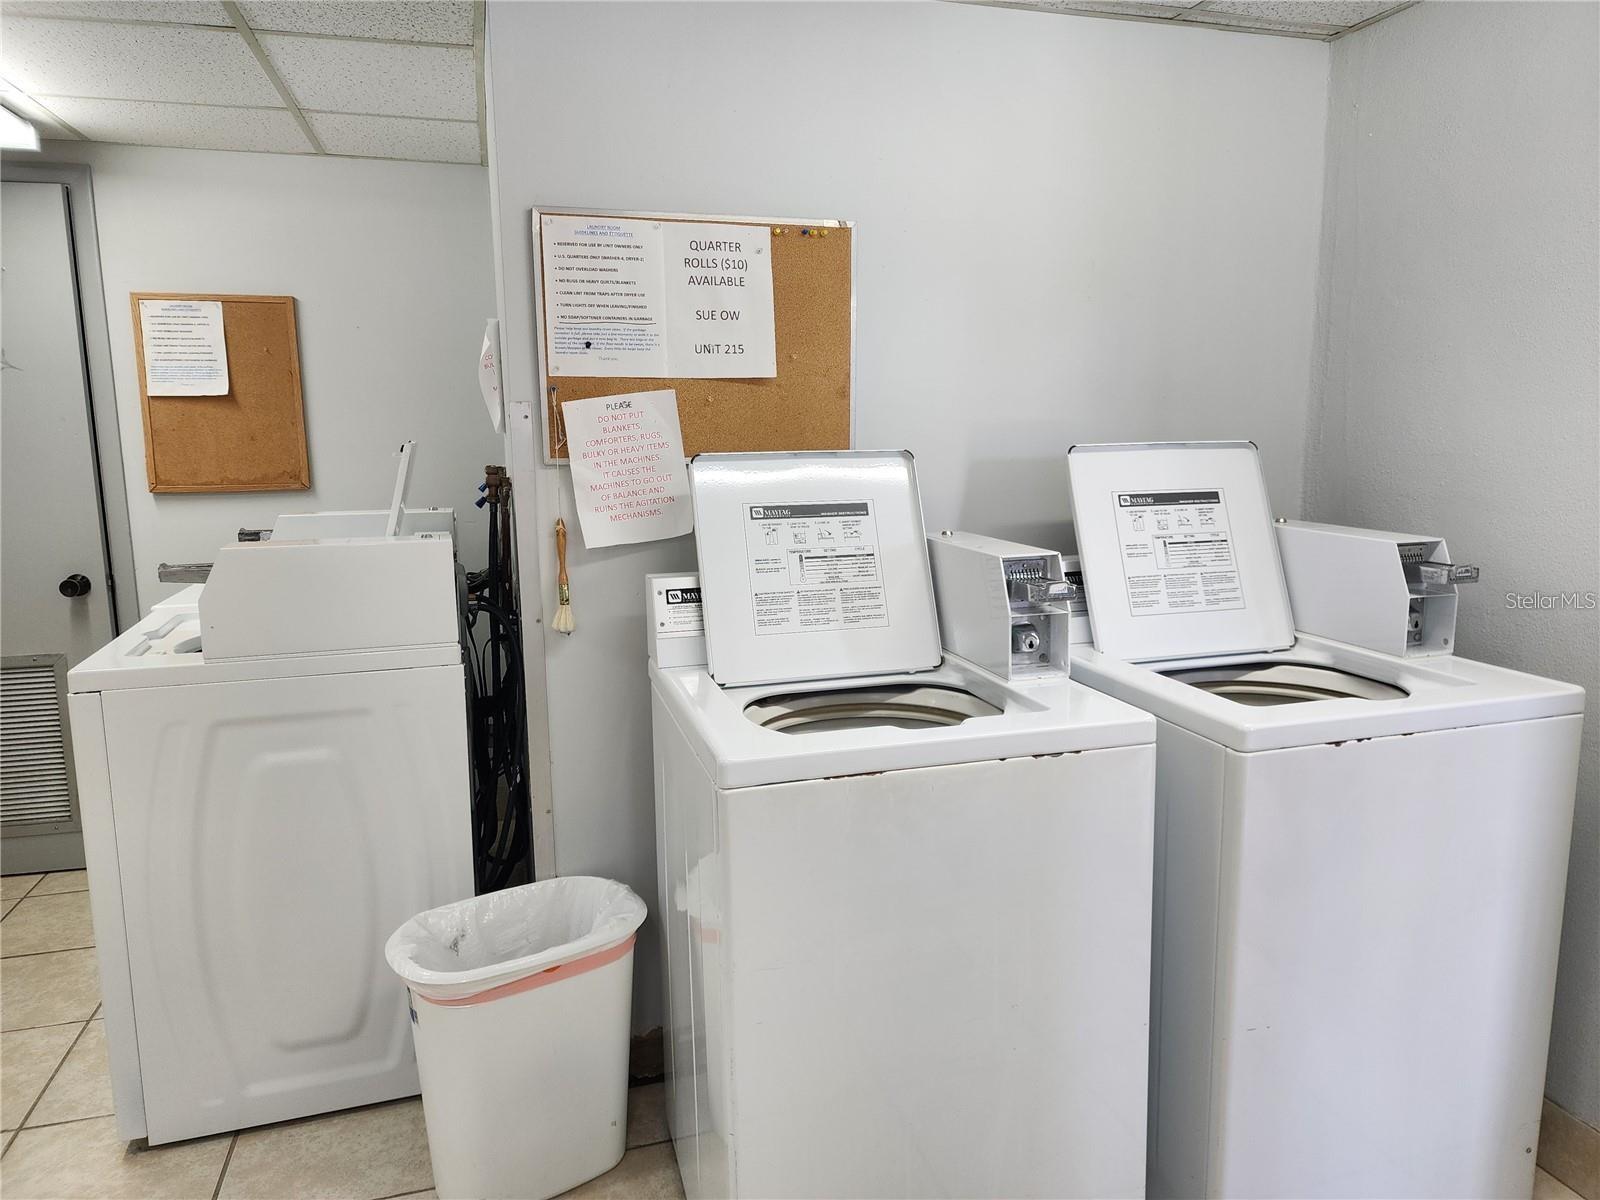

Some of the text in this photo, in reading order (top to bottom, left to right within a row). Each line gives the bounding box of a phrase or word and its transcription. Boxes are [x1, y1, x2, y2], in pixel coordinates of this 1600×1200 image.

[689, 240, 742, 253] QUARTER
[684, 258, 748, 272] ROLLS ($10)
[688, 275, 746, 287] AVAILABLE
[695, 310, 740, 321] SUE OW
[724, 344, 745, 355] 215
[606, 401, 633, 411] PLEASE
[597, 411, 645, 424] DO NOT PUT
[585, 435, 639, 448] COMFORTERS,
[582, 441, 670, 460] BULKY OR HEAVY ITEMS
[593, 461, 601, 469] IN
[603, 459, 618, 468] THE
[603, 465, 657, 479] IT CAUSES THE
[590, 474, 673, 492] MACHINES TO GO OUT
[601, 486, 665, 502] OF BALANCE AND
[594, 496, 675, 513] RUINS THE AGITATION
[763, 508, 791, 516] MAYTAG
